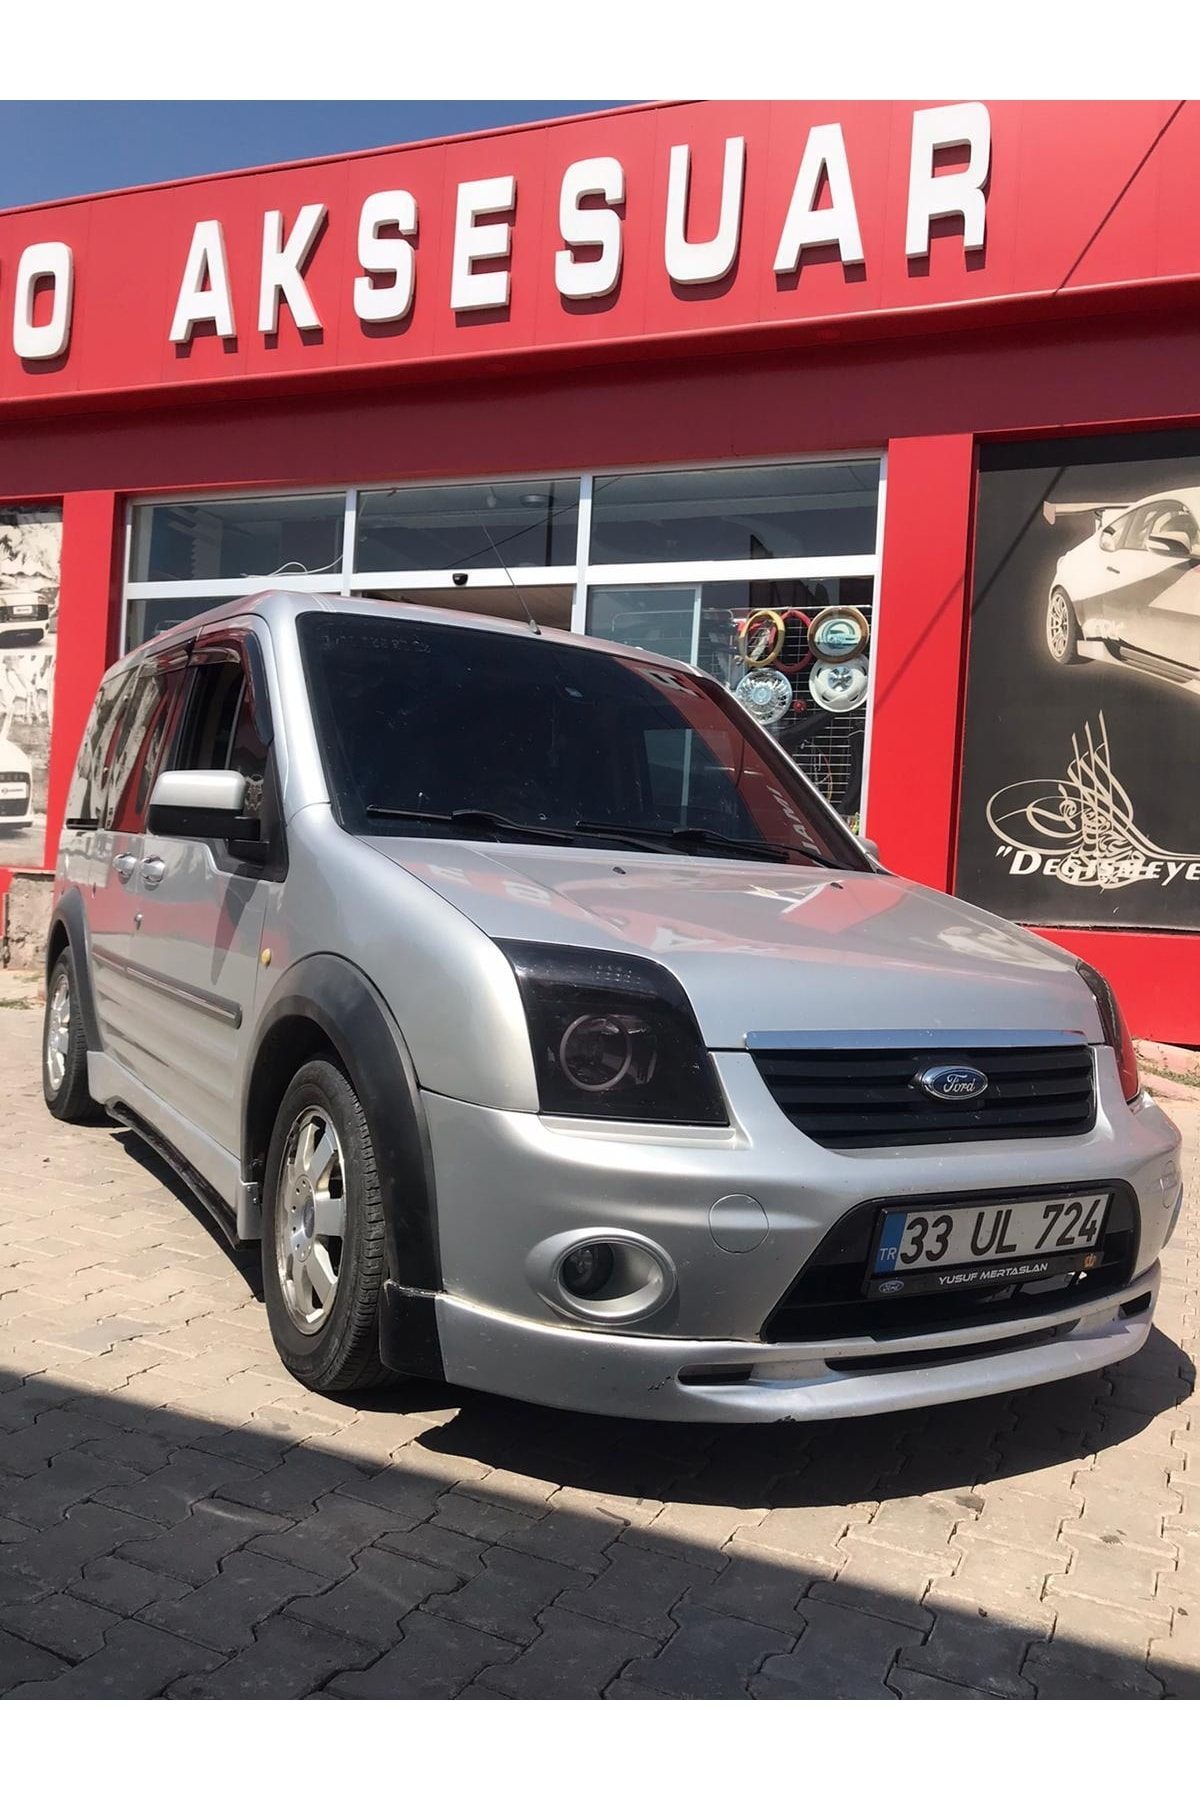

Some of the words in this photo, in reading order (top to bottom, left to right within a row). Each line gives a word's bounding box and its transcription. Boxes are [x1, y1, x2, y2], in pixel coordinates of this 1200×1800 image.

[168, 101, 991, 343] AKSESUAR
[943, 1073, 977, 1093] Ford
[900, 1214, 954, 1265] 33
[969, 1208, 1017, 1256] UL
[1034, 1199, 1101, 1250] 724
[879, 1247, 898, 1261] TR
[938, 1272, 979, 1286] YUSUF
[979, 1263, 1049, 1281] MERTASLAN
